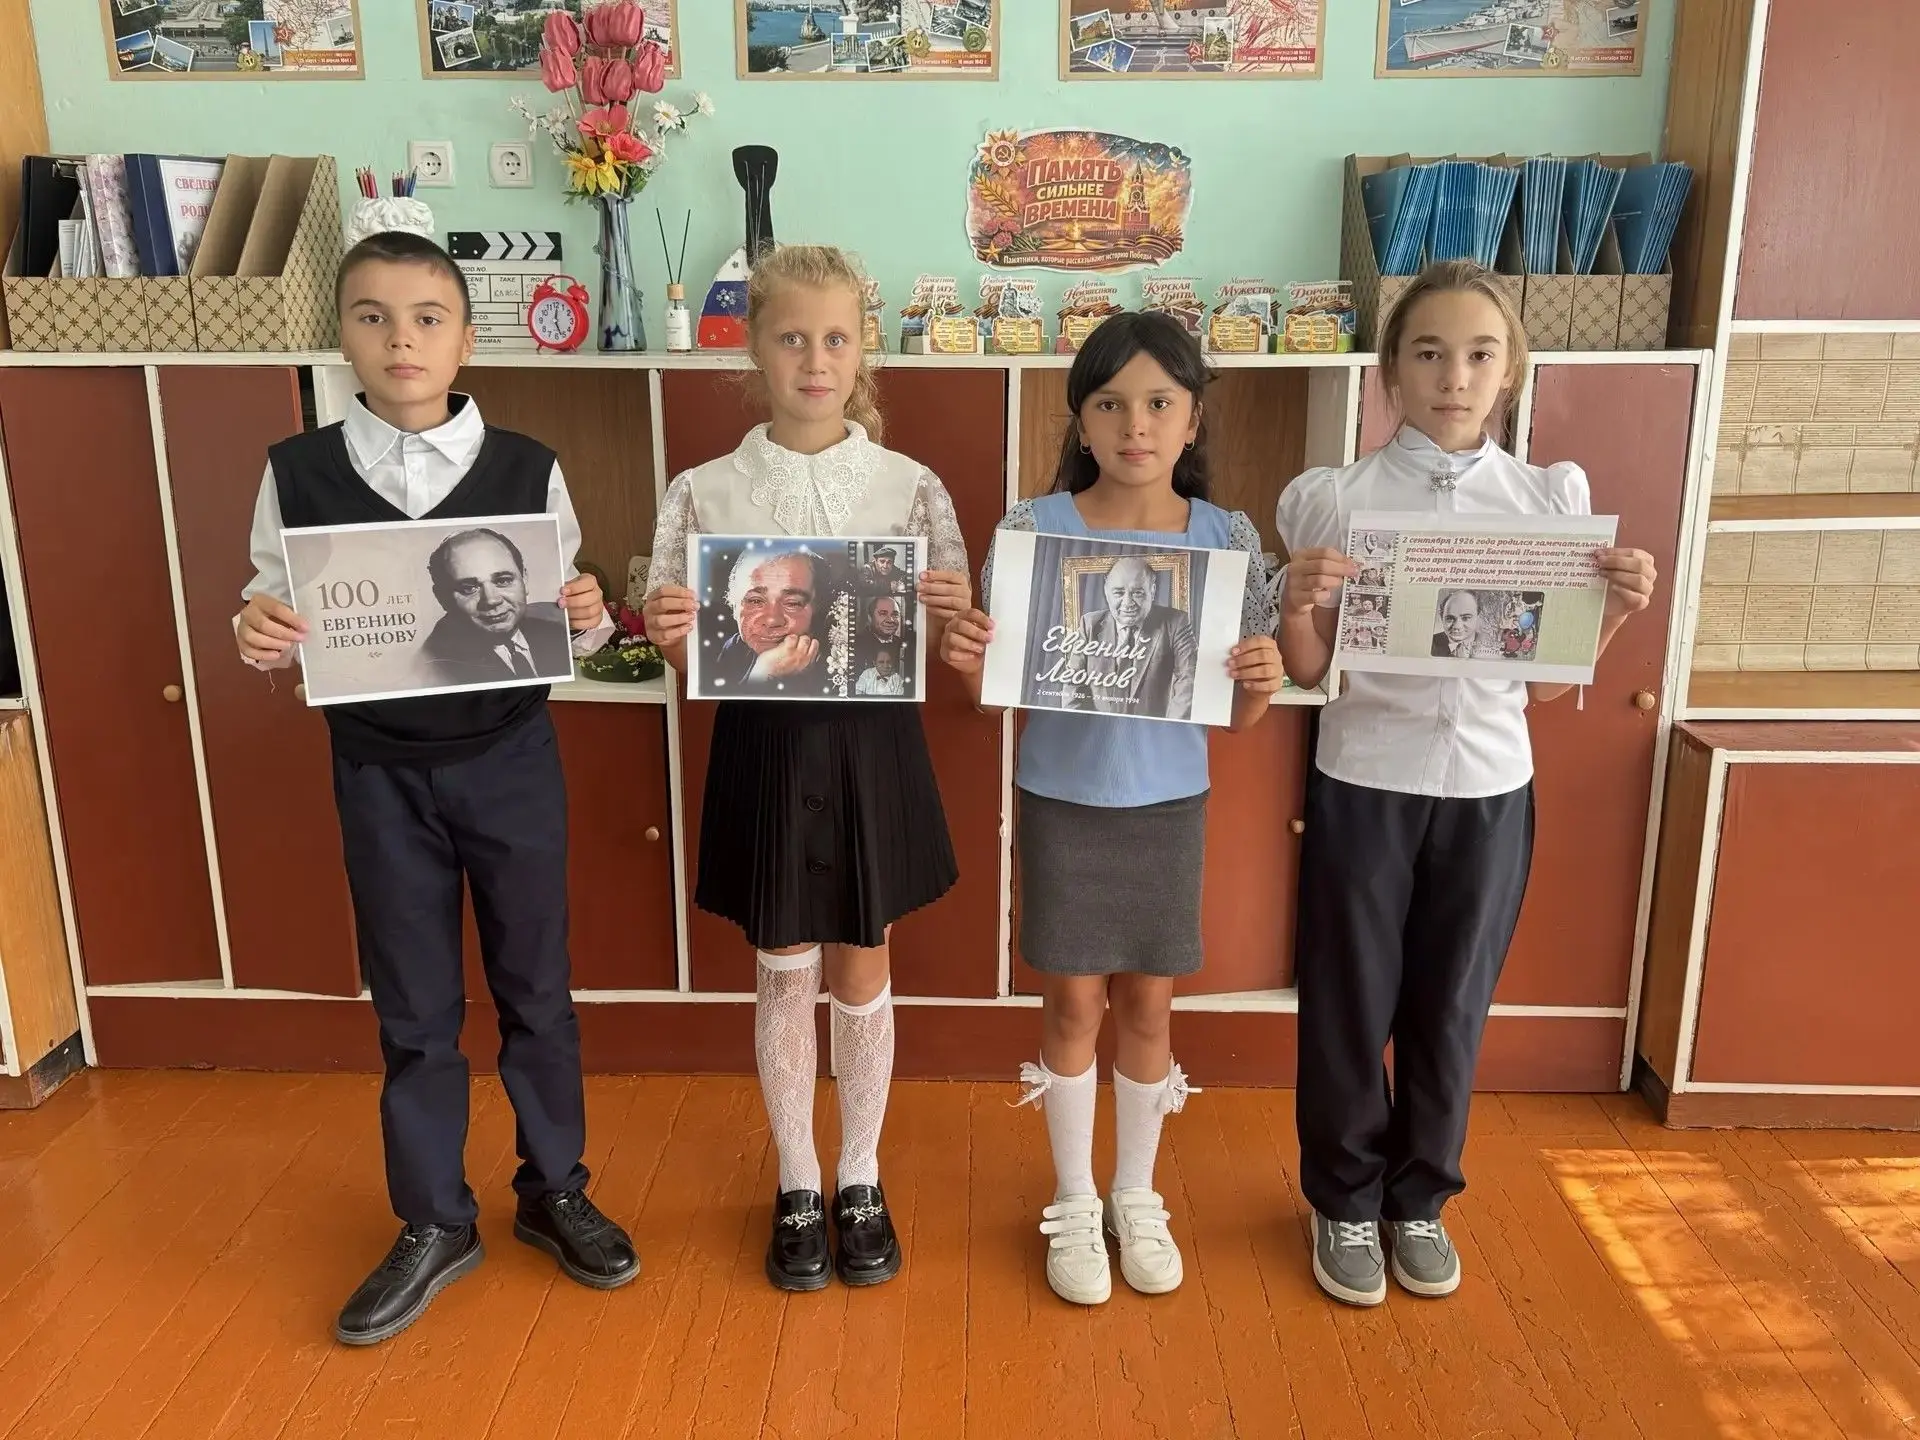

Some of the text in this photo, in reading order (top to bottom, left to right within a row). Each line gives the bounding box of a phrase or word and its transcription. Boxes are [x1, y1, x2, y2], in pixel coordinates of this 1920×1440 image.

[1027, 157, 1123, 188] ПАМЯТЬ
[1037, 182, 1104, 200] СИЛЬНЕЕ
[1023, 199, 1118, 228] ВРЕМЕНИ
[1003, 250, 1152, 265] Памятники, которые рассказывают историю Победы
[1409, 536, 1451, 545] сентября
[1475, 538, 1495, 546] года
[1497, 538, 1533, 547] родился
[1534, 539, 1608, 548] замечательный
[1404, 555, 1431, 563] Этого
[1432, 556, 1472, 565] артиста
[1513, 559, 1544, 567] любят
[1406, 546, 1595, 558] российский актер Евгений Павлович Леоно
[1404, 565, 1414, 573] до
[1450, 566, 1466, 575] При
[1468, 567, 1496, 575] одном
[1498, 568, 1551, 577] упоминании
[1409, 576, 1414, 584] у
[1416, 575, 1443, 583] людей
[1444, 577, 1462, 585] уже
[1465, 578, 1517, 586] появляется
[1518, 579, 1552, 587] улыбка
[317, 579, 413, 610] 100 ЛЕТ
[322, 612, 416, 632] ЕВГЕНИЮ
[325, 629, 418, 649] ЛЕОНОВУ
[1042, 625, 1151, 660] Евгений
[1035, 656, 1137, 689] Леонов
